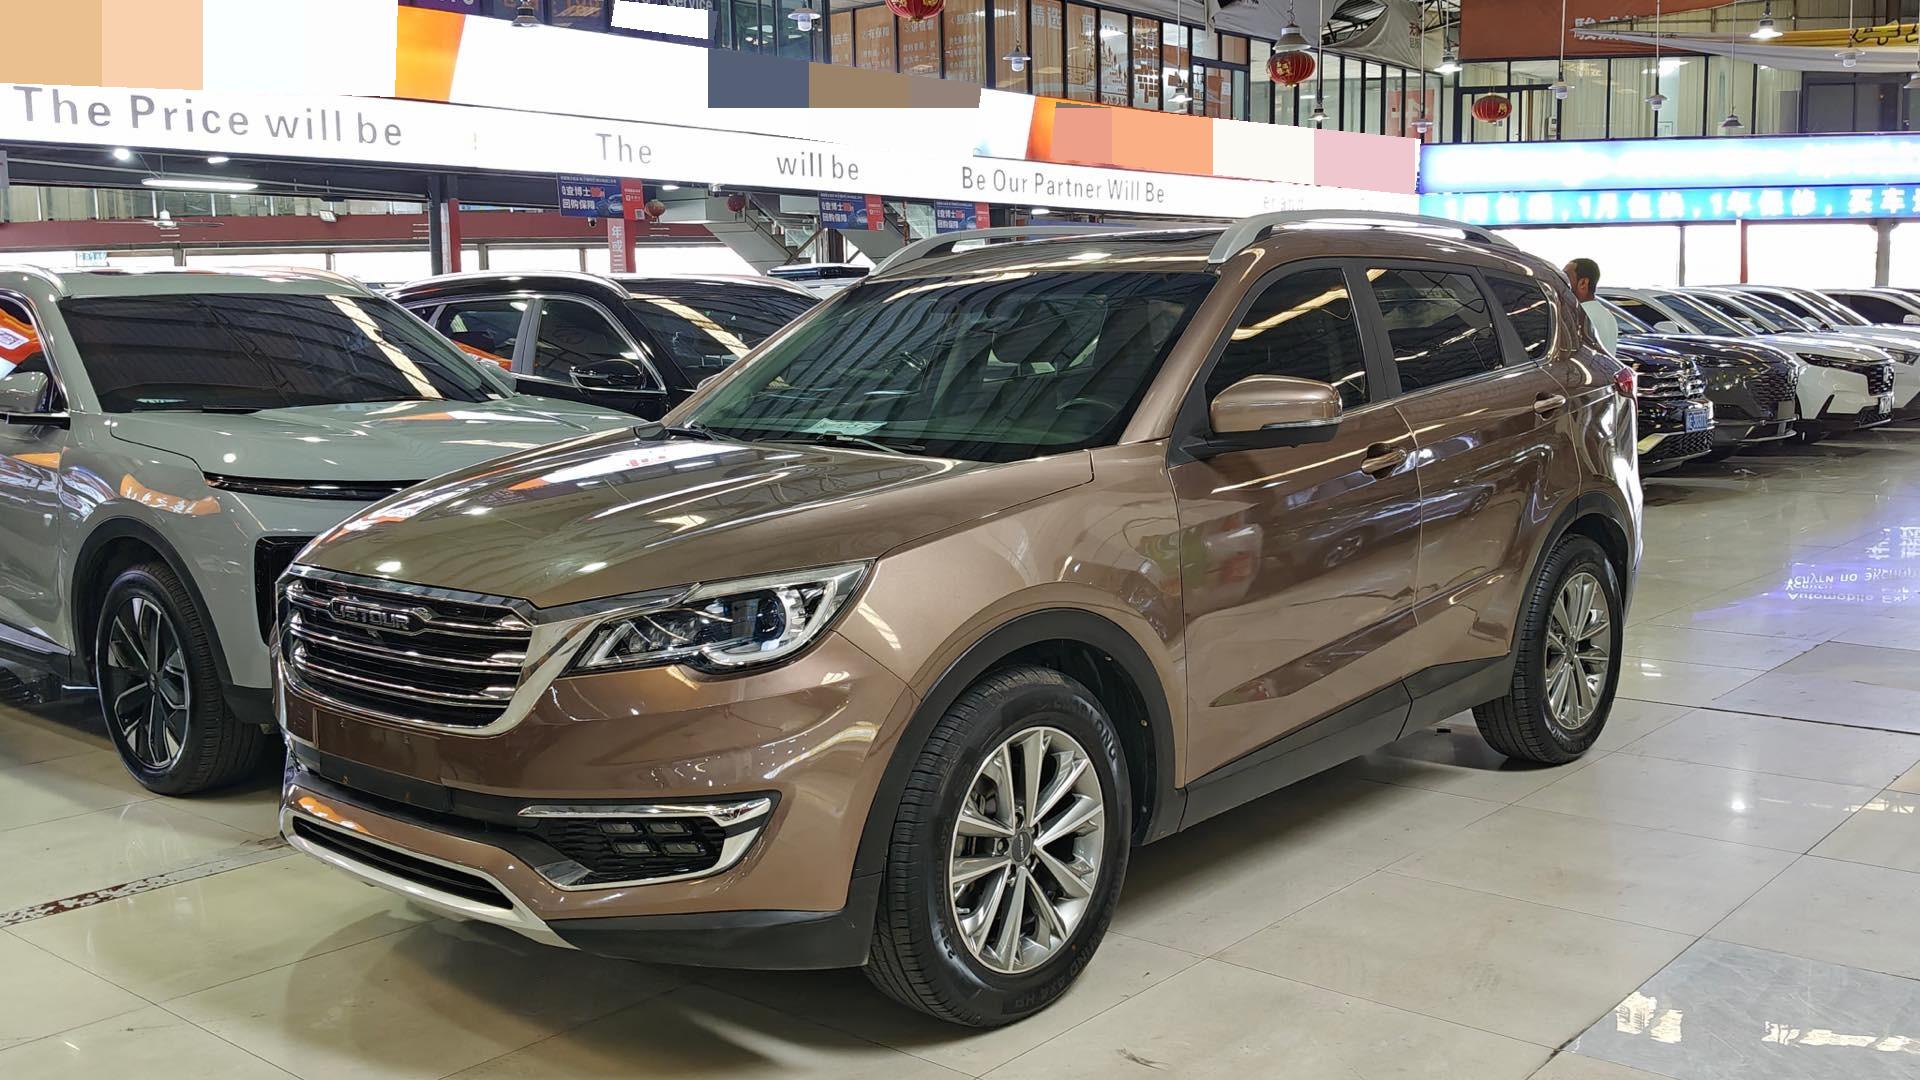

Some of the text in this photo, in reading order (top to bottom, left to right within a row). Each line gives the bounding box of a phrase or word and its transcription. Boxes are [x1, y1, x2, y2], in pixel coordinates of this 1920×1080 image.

[13, 85, 401, 146] The Price will be
[596, 133, 651, 164] The
[776, 152, 859, 180] will be
[962, 166, 1164, 203] Be Our Partner Will Be
[611, 225, 624, 272] 年或三
[335, 605, 409, 630] JETOUR
